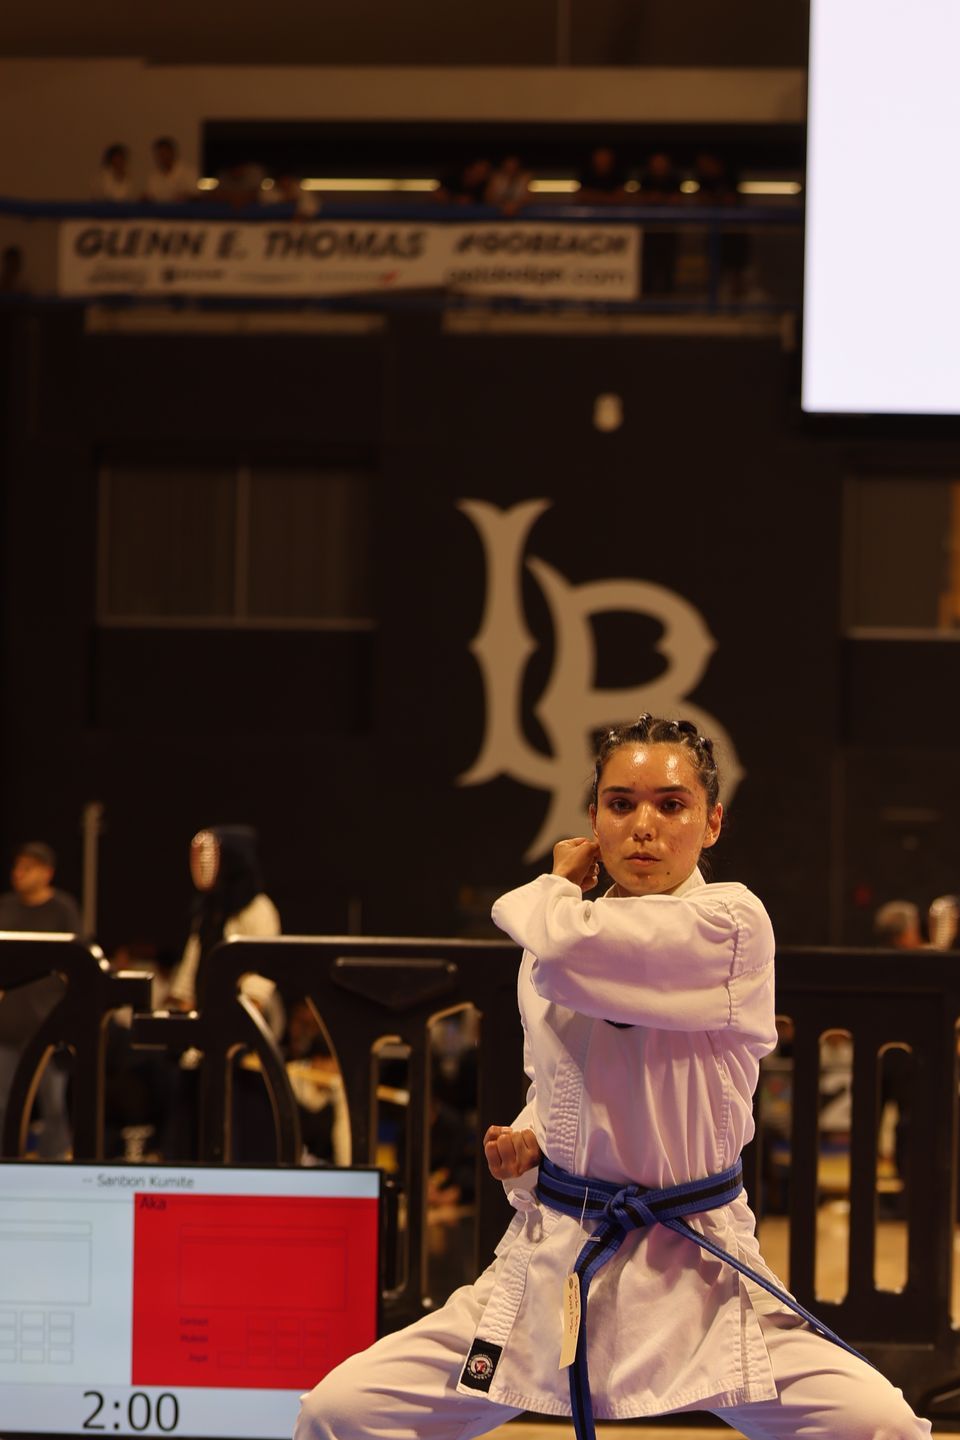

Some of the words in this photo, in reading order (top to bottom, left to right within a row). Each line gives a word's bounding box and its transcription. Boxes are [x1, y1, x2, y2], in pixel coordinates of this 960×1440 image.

[74, 227, 205, 259] GLENN
[264, 229, 425, 260] THOMAS
[97, 1173, 146, 1188] Sanbon
[149, 1174, 195, 1188] Kumite
[140, 1196, 167, 1211] Aka
[81, 1390, 181, 1432] 2:00
